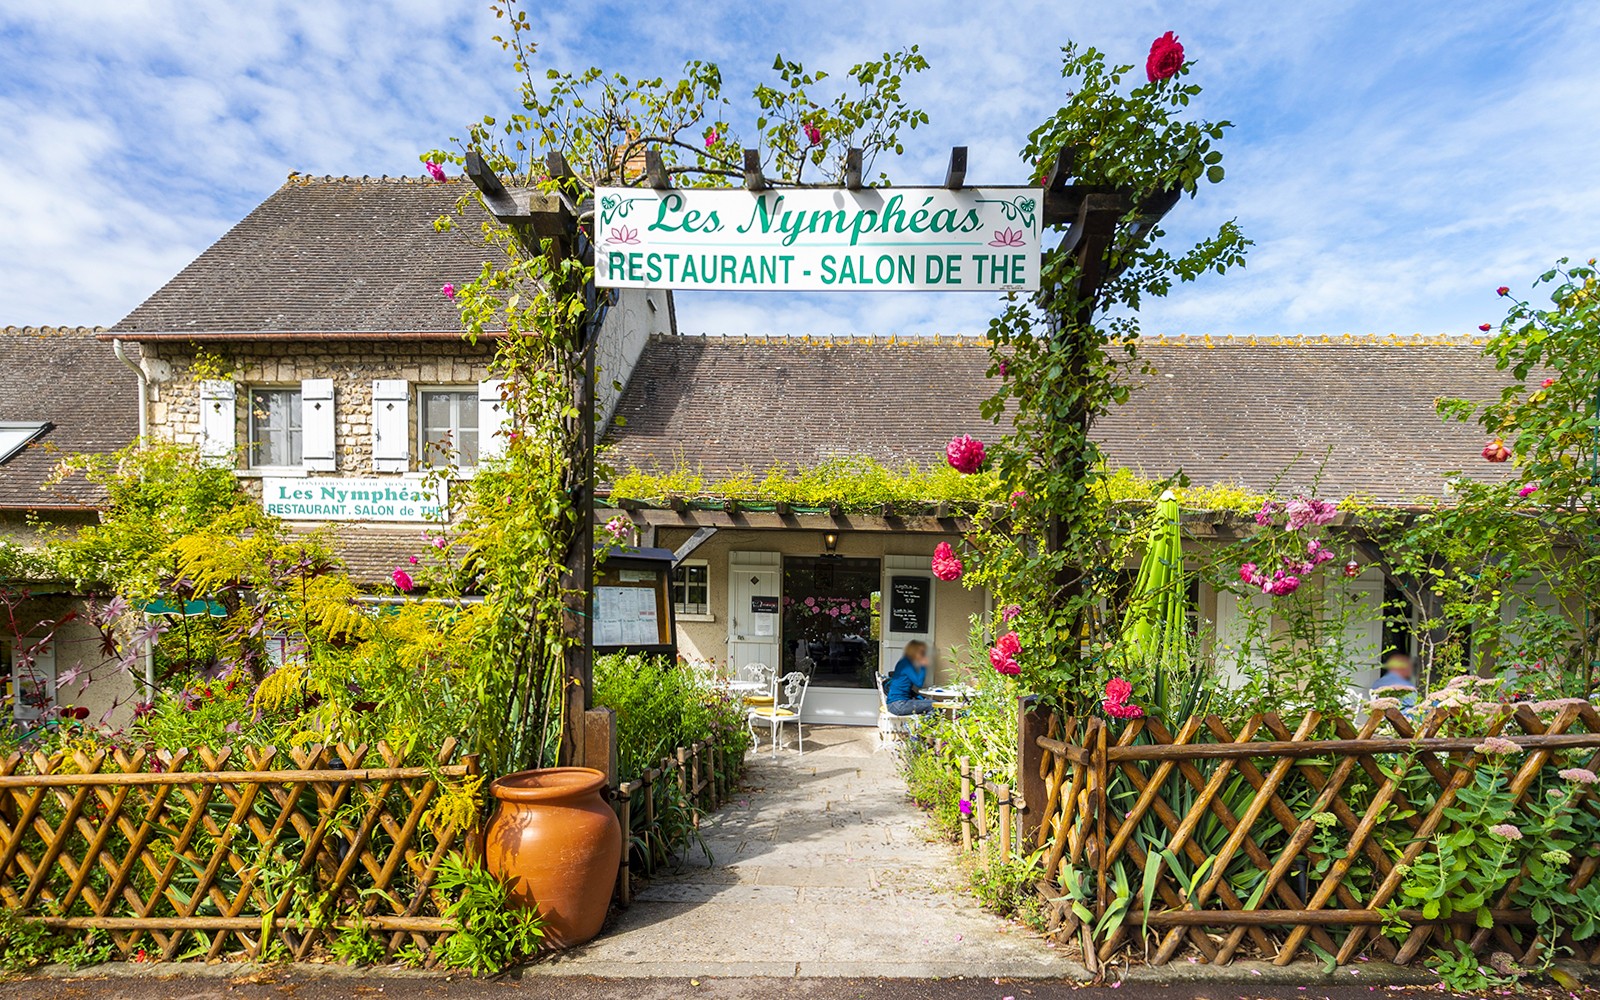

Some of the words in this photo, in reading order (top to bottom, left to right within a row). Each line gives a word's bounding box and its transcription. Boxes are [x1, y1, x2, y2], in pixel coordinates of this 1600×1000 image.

[648, 194, 725, 233] Les
[737, 194, 985, 247] Nymphéas
[608, 251, 795, 284] RESTAURANT
[820, 255, 916, 285] SALON
[925, 254, 962, 285] DE
[972, 254, 1026, 285] THE
[279, 486, 313, 500] Les
[354, 505, 394, 516] SALON
[399, 505, 415, 516] de
